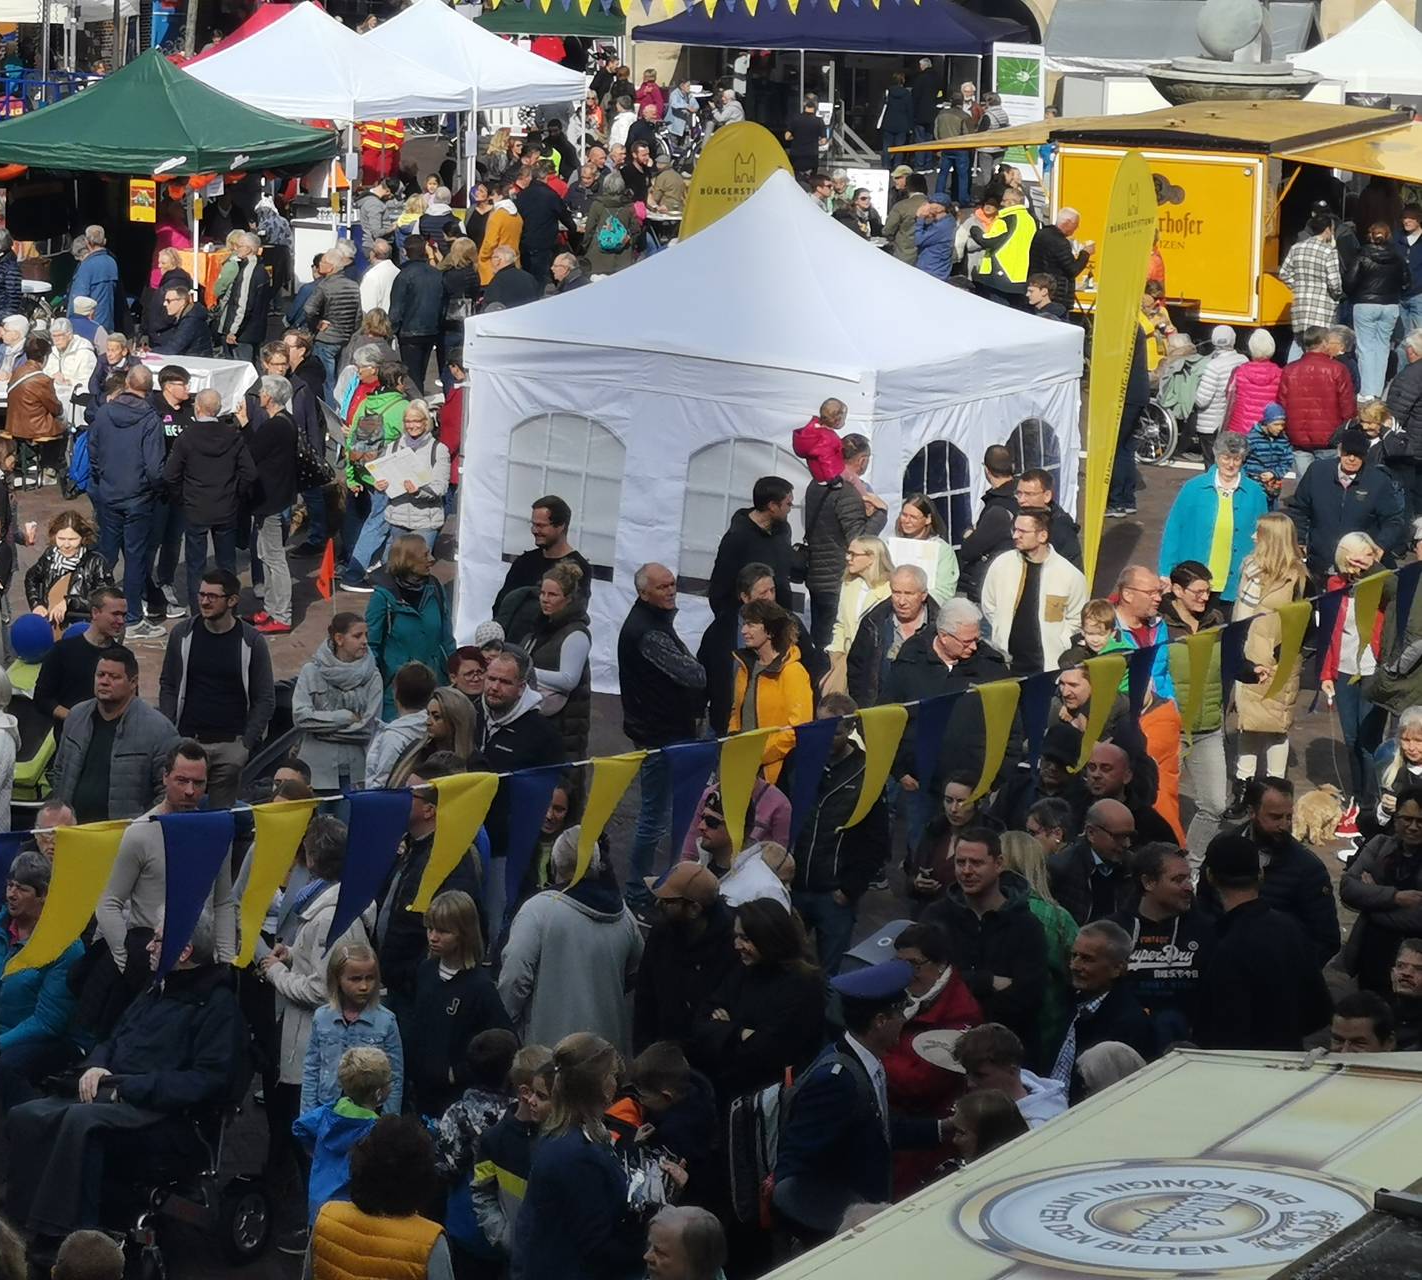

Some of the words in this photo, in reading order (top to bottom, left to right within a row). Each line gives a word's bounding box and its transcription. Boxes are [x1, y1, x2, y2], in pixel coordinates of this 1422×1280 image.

[1158, 211, 1204, 239] rhofer
[1094, 1179, 1236, 1195] KÖNIGIN
[1238, 1184, 1306, 1206] EINE
[1039, 1192, 1092, 1224] UNTER
[1044, 1223, 1098, 1245] DEN
[1096, 1240, 1229, 1256] BIEREN
